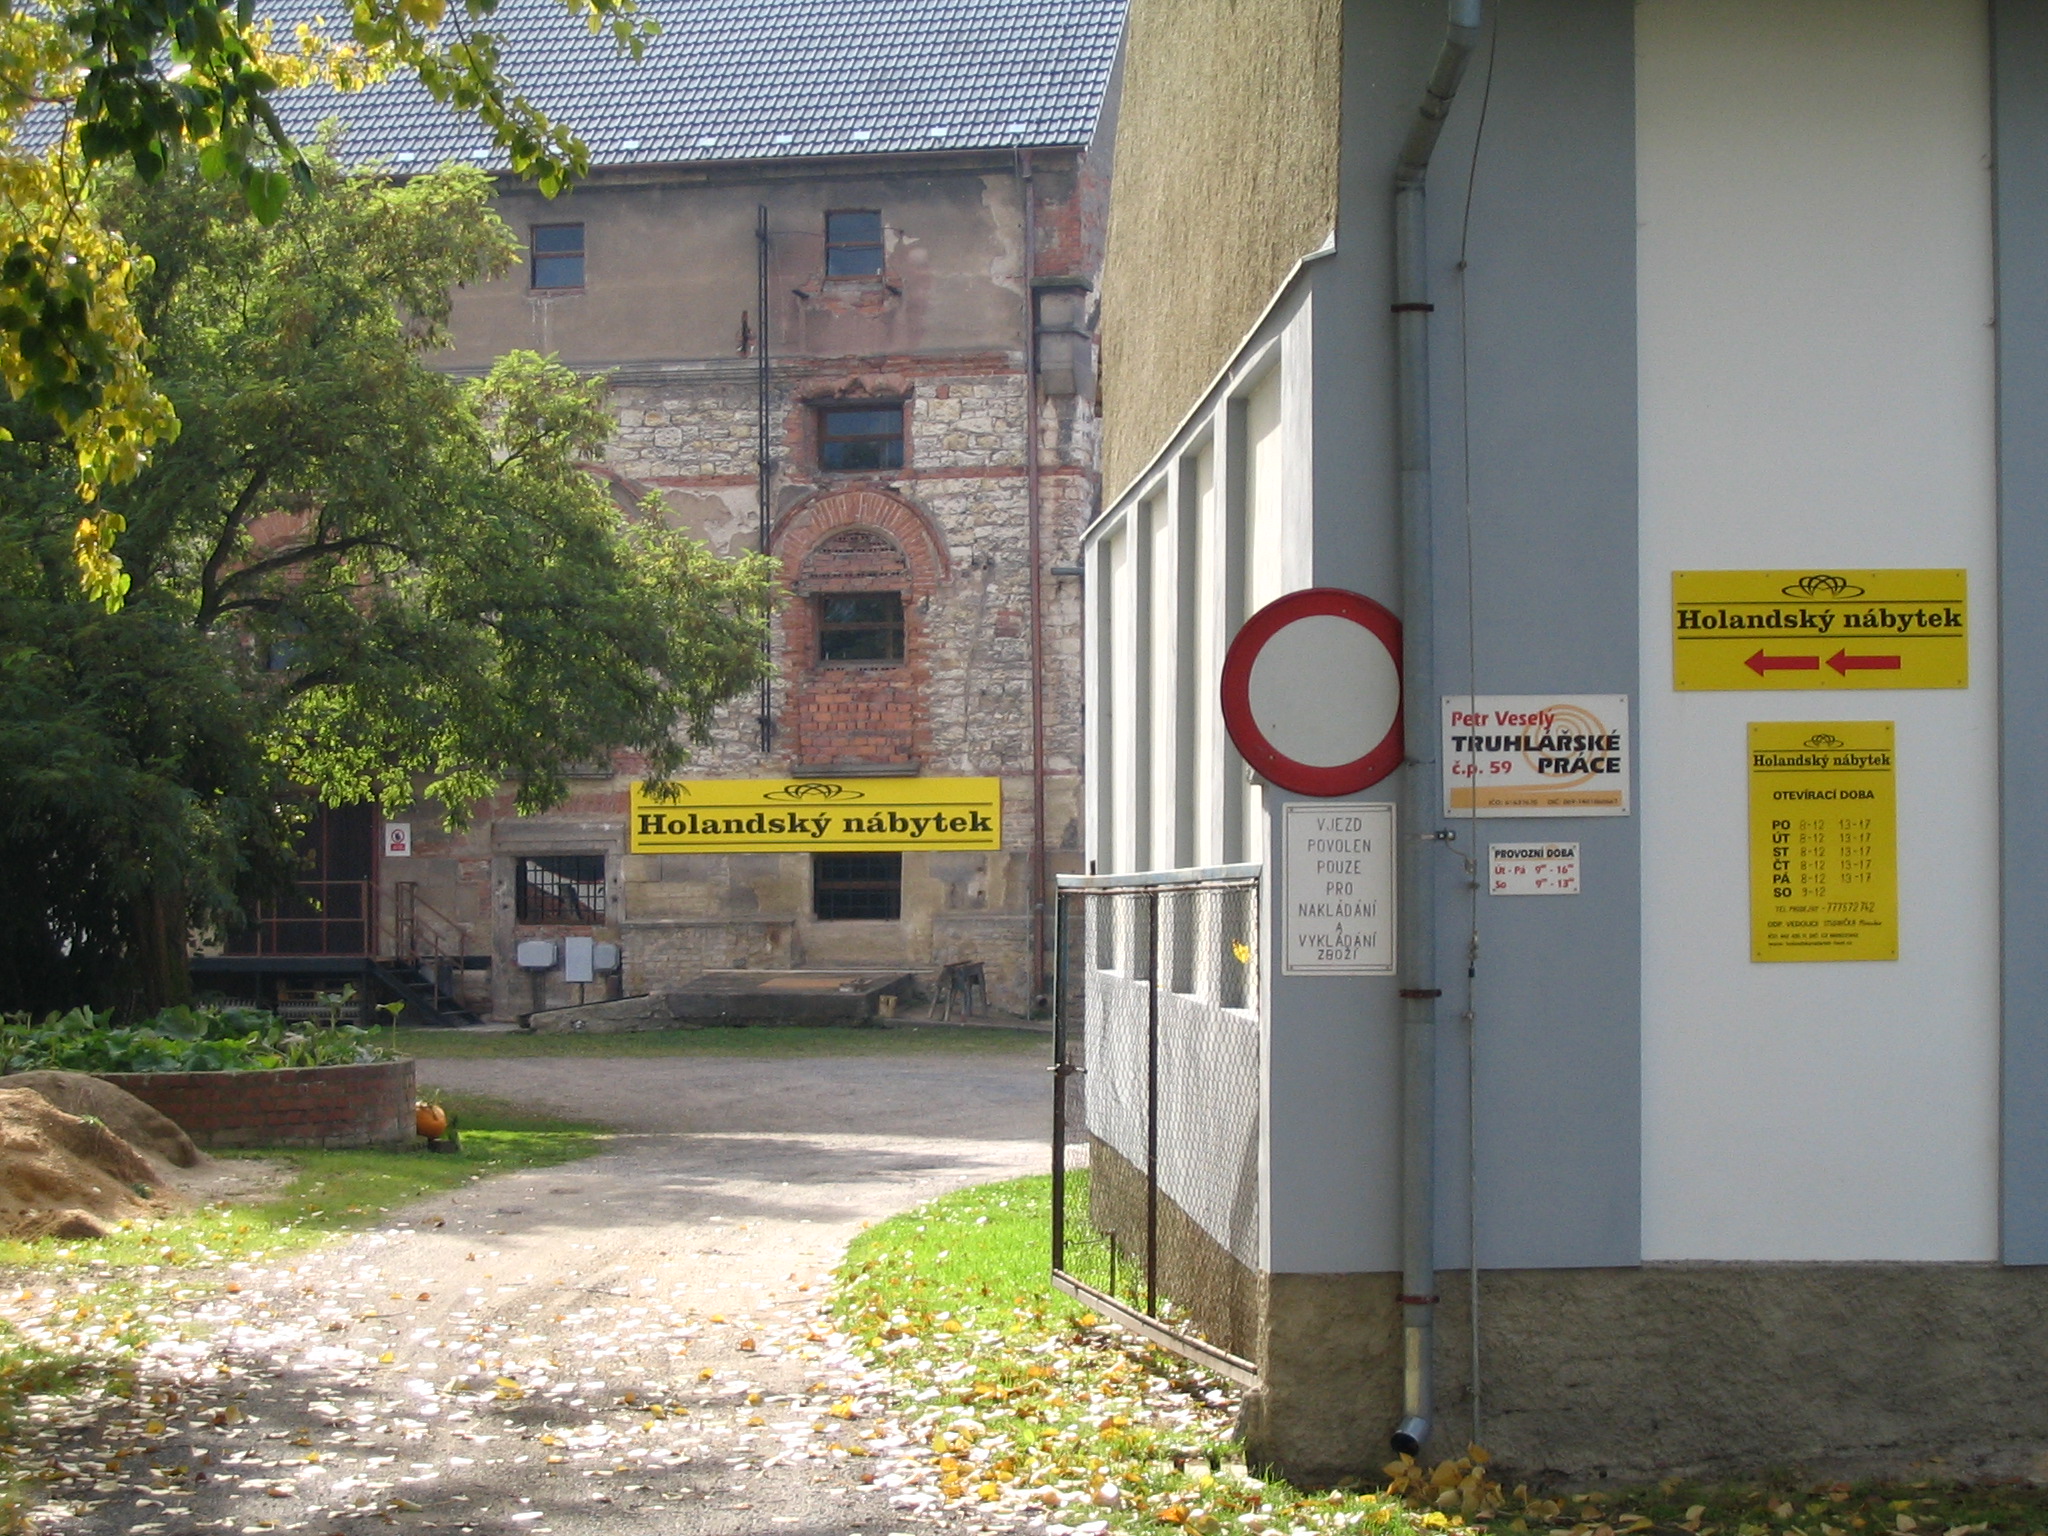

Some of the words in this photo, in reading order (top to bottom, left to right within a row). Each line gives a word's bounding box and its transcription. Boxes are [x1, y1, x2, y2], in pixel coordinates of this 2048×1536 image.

[1677, 608, 1835, 633] Holandský
[1843, 607, 1962, 633] nábytek
[1452, 711, 1489, 726] Petr
[1495, 708, 1554, 730] Veselý
[1452, 729, 1620, 752] TRUHLÁŘSKÉ
[1490, 760, 1512, 775] 59
[1538, 752, 1620, 773] PRÁCE
[1753, 753, 1829, 768] Holandský
[1833, 753, 1890, 768] nábytek
[1773, 788, 1837, 800] OTEVÍRACÍ
[1840, 790, 1874, 800] DOBA
[637, 811, 832, 838] Holandský
[843, 810, 993, 838] nábytek
[1317, 817, 1362, 832] VJEZD
[1772, 820, 1791, 830] PO
[1772, 831, 1791, 843] ÚT
[1307, 838, 1371, 853] POVOLEN
[1495, 846, 1544, 858] PROVOZNÍ
[1547, 848, 1575, 857] DOBA
[1773, 846, 1790, 857] ST
[1317, 860, 1361, 874] POUZE
[1773, 858, 1791, 870] ČT
[1773, 871, 1791, 884] PÁ
[1326, 881, 1353, 896] PRO
[1495, 881, 1507, 889] So
[1773, 887, 1792, 898] SO
[1299, 899, 1377, 917] NAKLÁDÁNÍ
[1336, 922, 1343, 932] A
[1299, 931, 1377, 948] VYKLÁDÁNÍ
[1317, 946, 1359, 960] ZBOŽÍ
